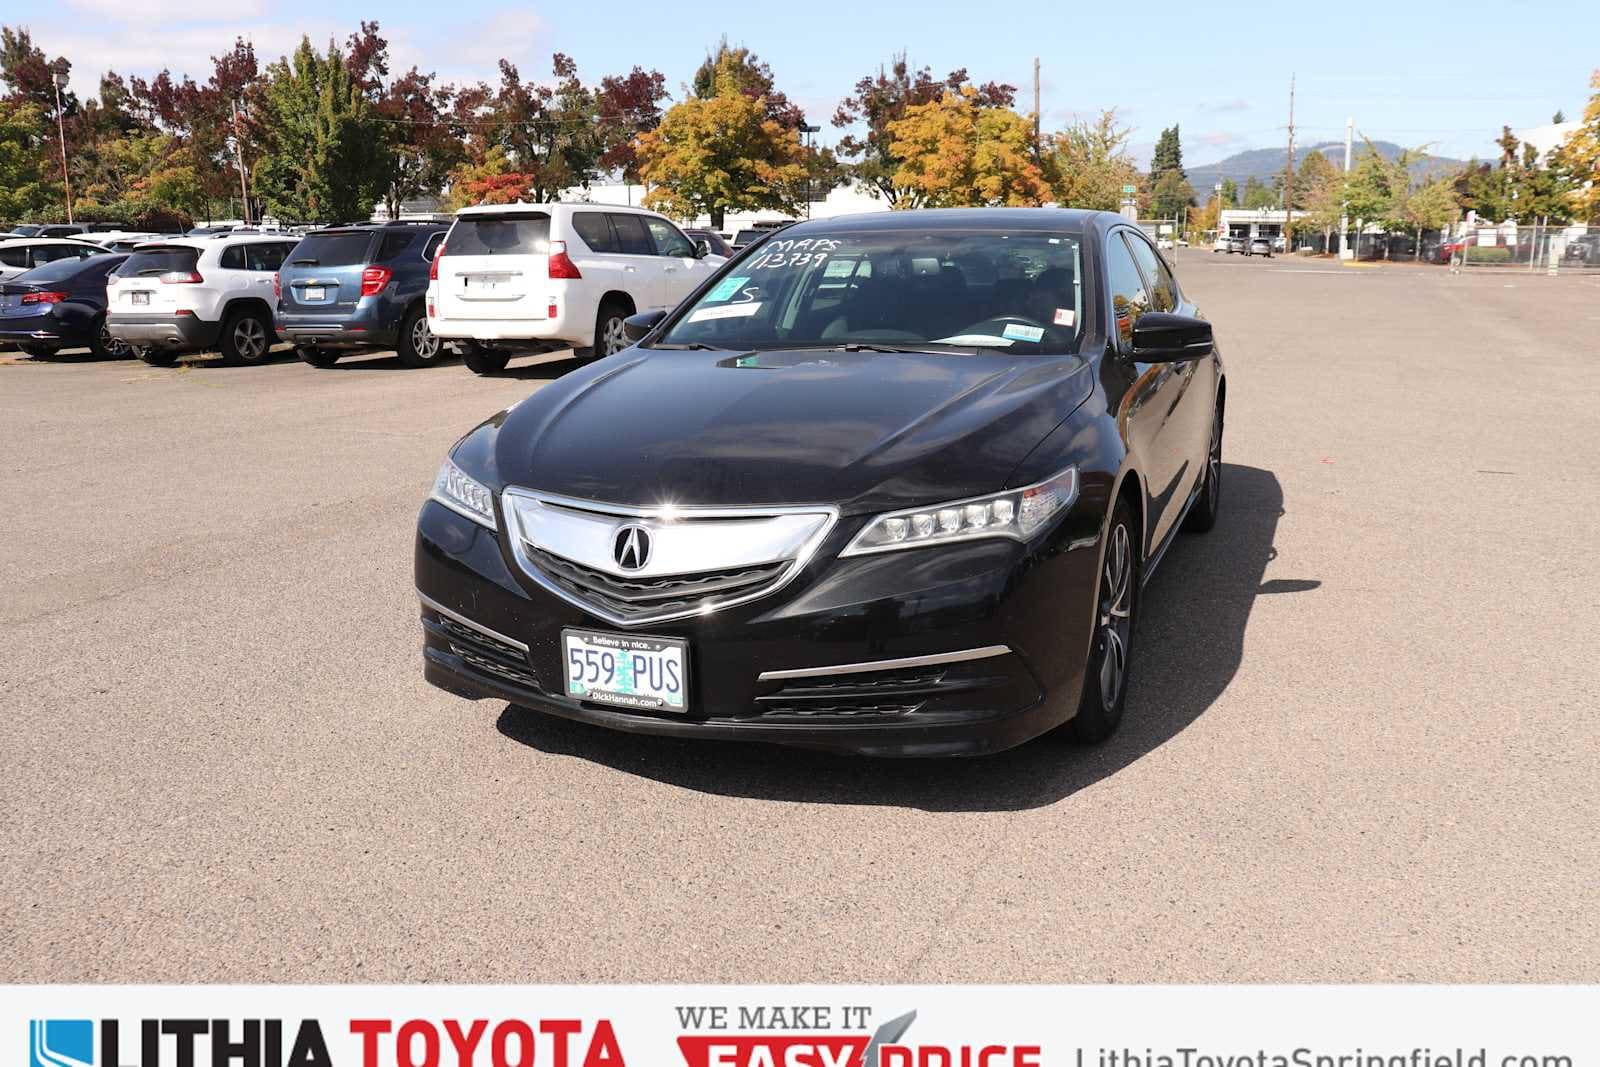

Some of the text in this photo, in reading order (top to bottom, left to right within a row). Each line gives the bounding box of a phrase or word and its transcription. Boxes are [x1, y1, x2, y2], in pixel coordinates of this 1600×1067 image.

[592, 636, 651, 650] Believe in nice.
[569, 648, 680, 693] 559 PUS
[592, 692, 657, 708] DickHannah.com
